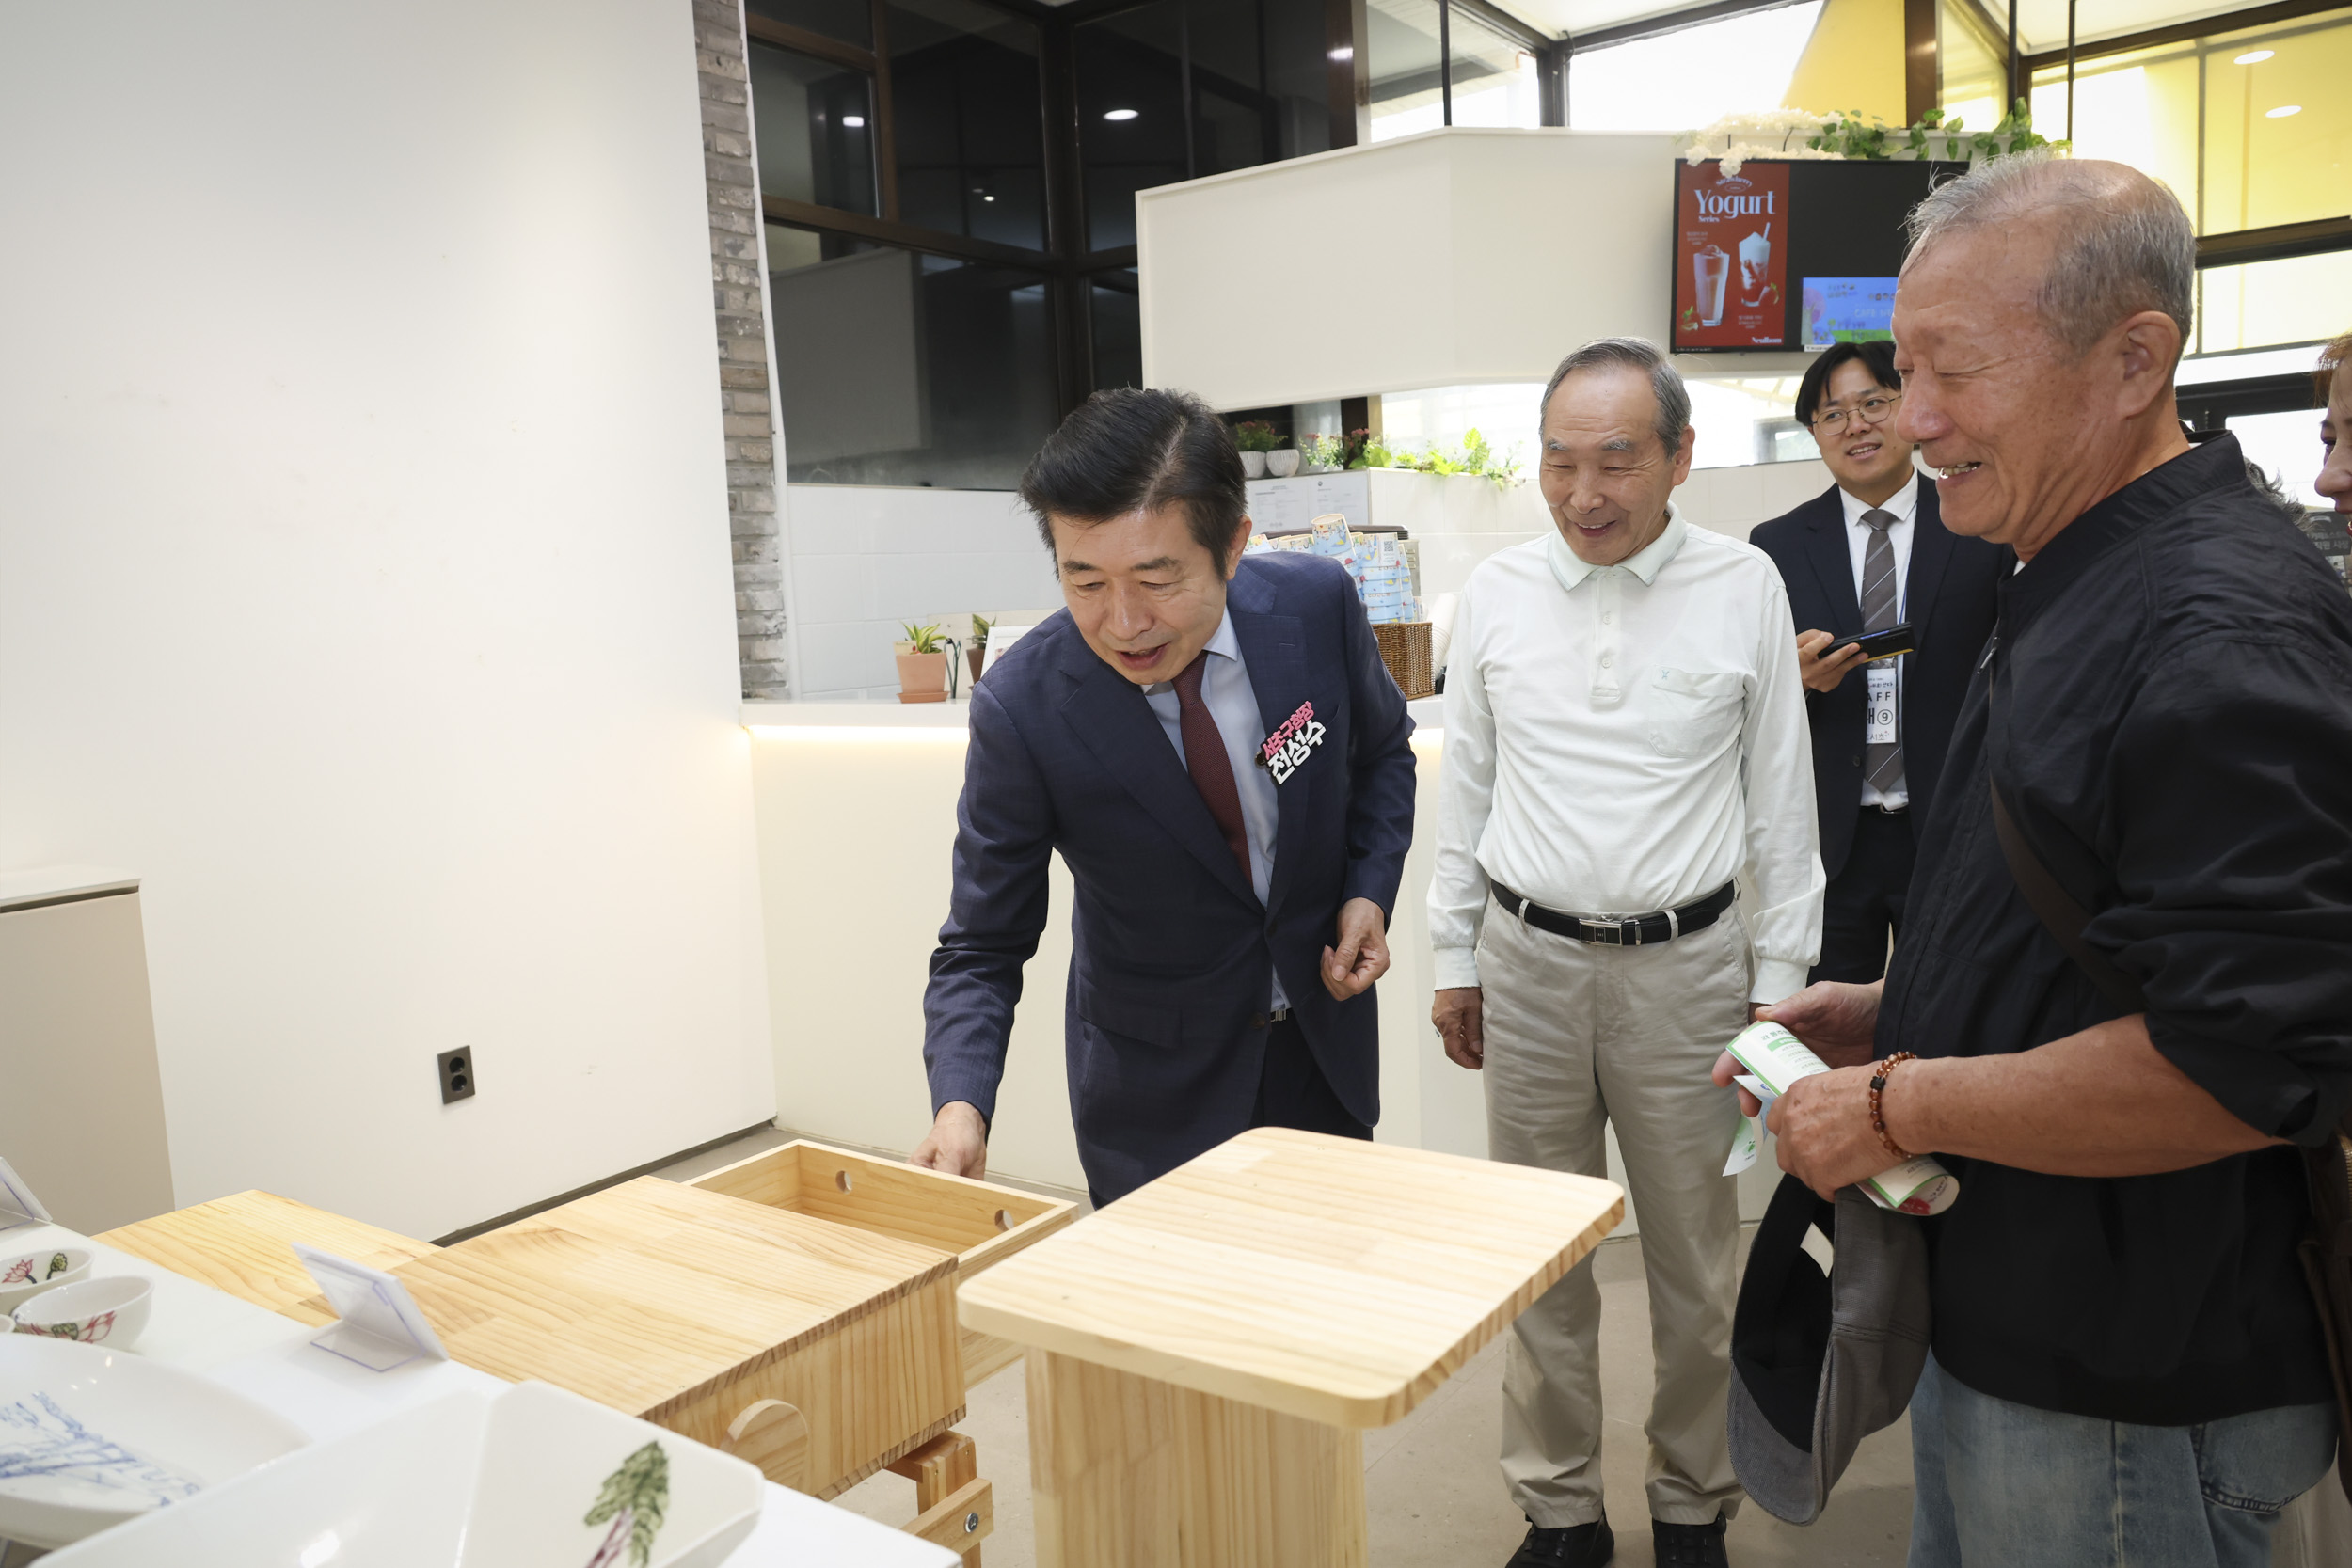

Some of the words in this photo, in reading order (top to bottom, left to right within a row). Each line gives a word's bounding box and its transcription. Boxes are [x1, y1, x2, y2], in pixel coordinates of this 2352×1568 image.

[1693, 189, 1776, 219] Yogurt
[1867, 691, 1891, 702] AFF
[1262, 700, 1315, 760] 서초구청장
[1267, 720, 1327, 784] 전성수
